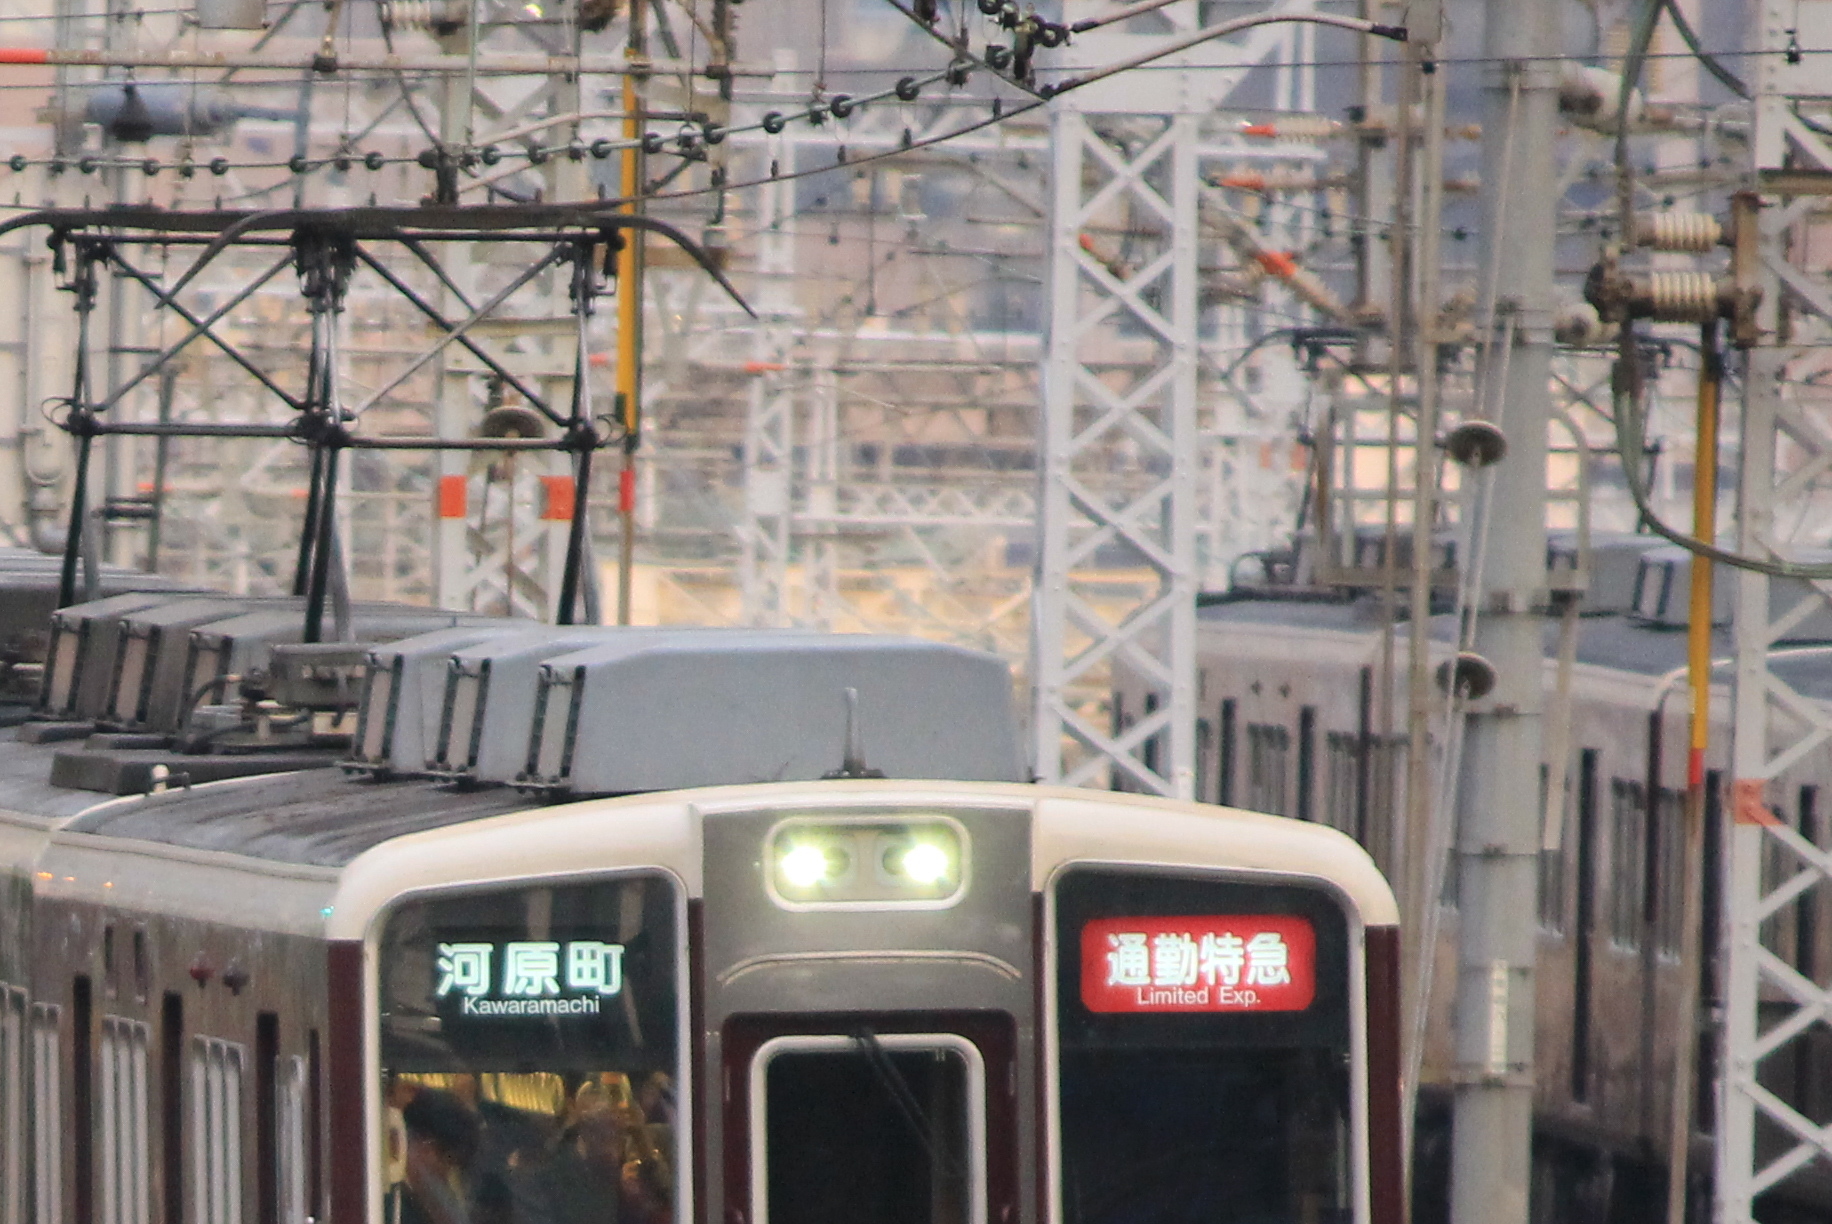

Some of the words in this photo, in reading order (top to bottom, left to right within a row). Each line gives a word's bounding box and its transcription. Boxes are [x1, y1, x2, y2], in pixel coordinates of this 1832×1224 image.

[436, 940, 625, 996] 河原町
[1106, 931, 1292, 986] 通勤特急
[464, 996, 600, 1015] Kawaramachi
[1137, 986, 1209, 1005] Limited
[1219, 986, 1261, 1007] Exp.
